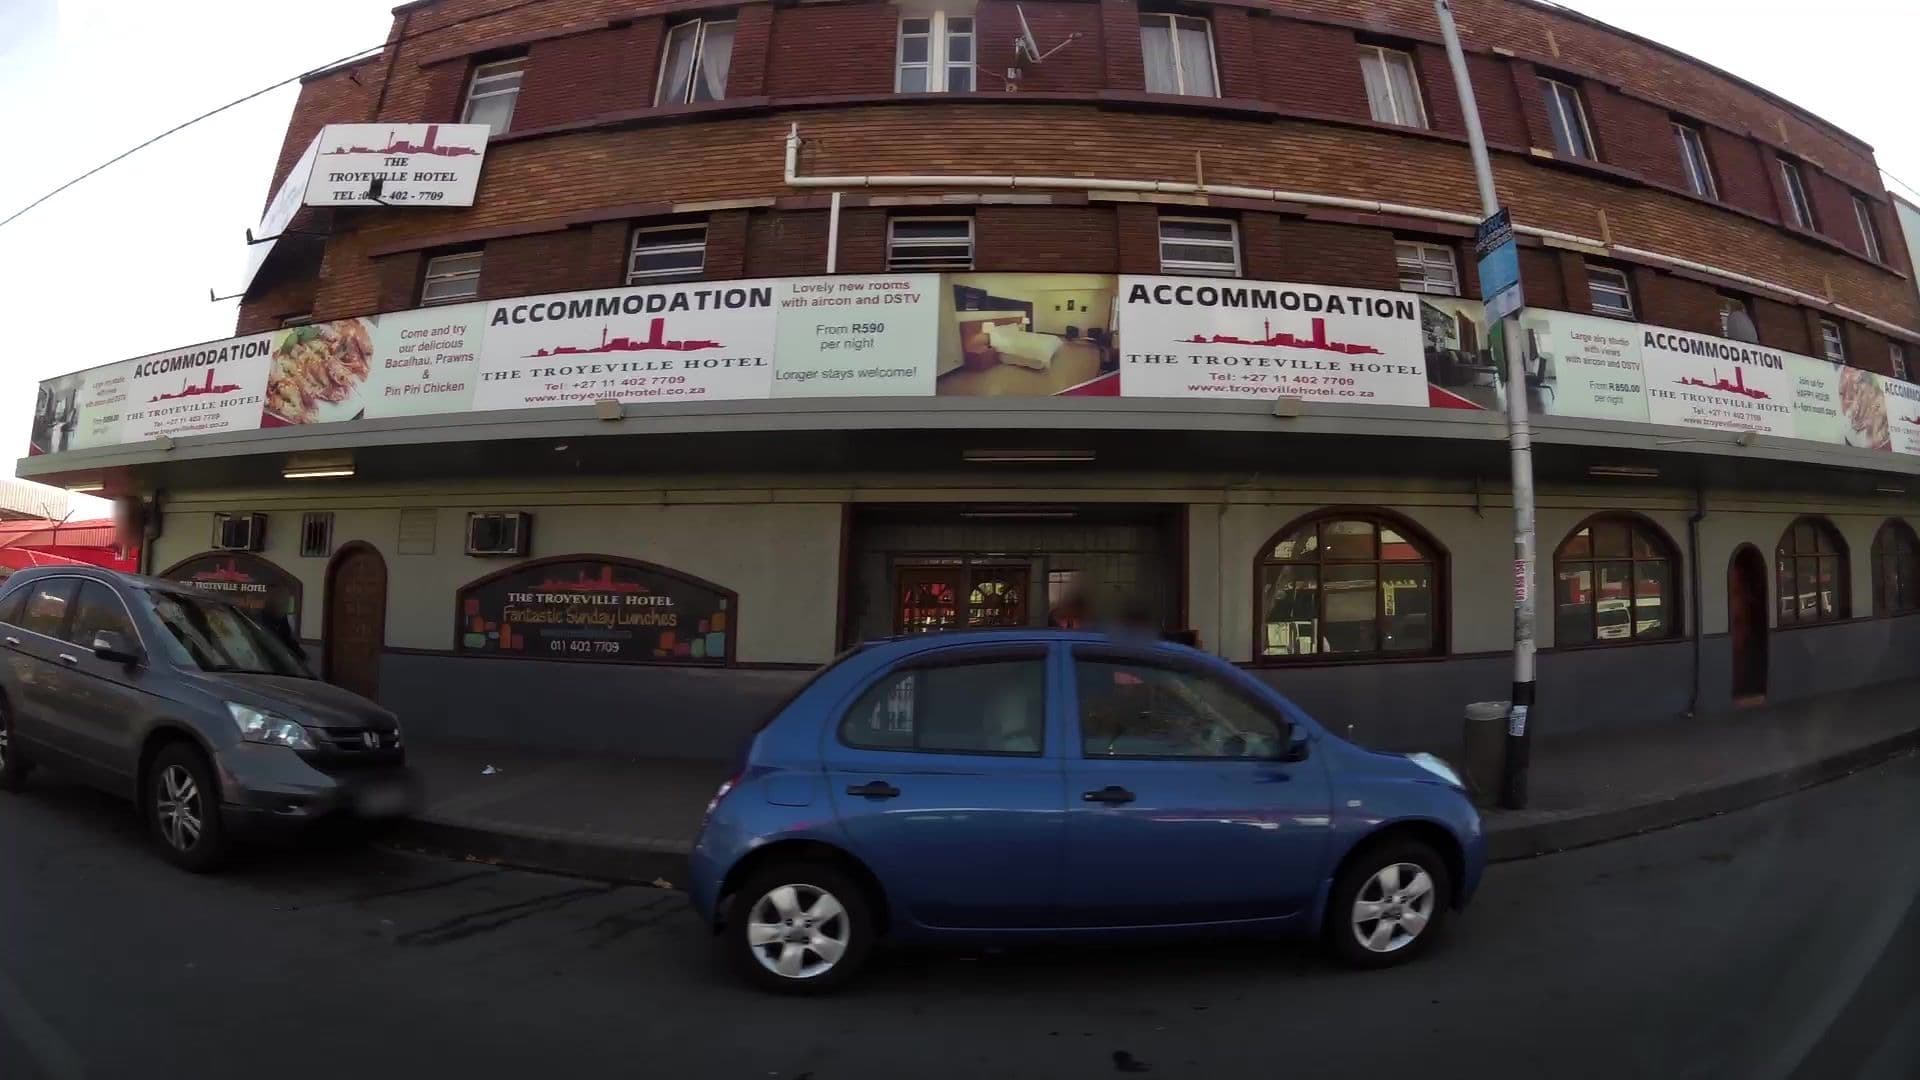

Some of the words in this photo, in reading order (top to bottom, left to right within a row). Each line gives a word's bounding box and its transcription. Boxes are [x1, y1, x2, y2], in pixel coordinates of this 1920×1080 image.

[383, 157, 409, 167] THE
[328, 172, 408, 182] TROYEVILLE
[413, 172, 458, 182] HOTEL
[389, 191, 408, 201] 402
[419, 191, 444, 201] 7709
[792, 283, 834, 294] Lovely
[839, 282, 864, 291] new
[868, 281, 910, 290] rooms
[491, 287, 772, 326] ACCOMMODATION
[781, 296, 808, 308] with
[811, 296, 852, 306] aircon
[856, 295, 880, 305] and
[884, 294, 920, 304] DSTV
[1128, 283, 1415, 321] ACCOMMODATION
[400, 327, 428, 340] Come
[431, 326, 450, 338] and
[452, 324, 467, 337] try
[816, 324, 848, 336] From
[852, 323, 884, 334] R590
[1571, 329, 1591, 342] Large
[399, 344, 415, 353] our
[418, 338, 464, 352] delicious
[820, 340, 840, 351] per
[844, 338, 874, 350] night
[1644, 332, 1783, 370] ACCOMMODATION
[134, 339, 271, 379] ACCOMMODATION
[435, 351, 474, 365] Prawns
[1126, 354, 1179, 364] THE
[1188, 356, 1340, 371] TROYEVILLE
[1350, 362, 1422, 375] HOTEL
[481, 370, 522, 381] THE
[529, 360, 674, 378] TROYEVILLE
[685, 357, 768, 370] HOTEL
[1621, 361, 1640, 370] DSTV
[422, 369, 431, 380] &
[775, 369, 818, 382] Longer
[821, 368, 854, 380] stays
[858, 366, 917, 378] welcome!
[1241, 374, 1267, 382] +27
[1293, 376, 1318, 384] 402
[1323, 376, 1354, 386] 7709
[404, 383, 421, 395] Piri
[423, 381, 465, 395] Chicken
[572, 379, 597, 389] +27
[602, 379, 615, 388] 11
[620, 376, 647, 387] 402
[651, 375, 685, 385] 7709
[126, 412, 144, 420] THE
[148, 402, 216, 417] TROYEVILLE
[220, 396, 262, 407] HOTEL
[1649, 389, 1677, 400] THE
[1681, 393, 1753, 409] TROYEVILLE
[1757, 403, 1791, 414] HOTEL
[240, 583, 267, 593] HOTEL
[508, 592, 533, 603] THE
[535, 593, 619, 605] TROYEVILLE
[626, 596, 674, 606] HOTEL
[503, 605, 561, 623] Fantastic
[566, 608, 615, 629] Sunday
[618, 608, 677, 626] Lunches
[550, 641, 566, 651] 011
[570, 641, 591, 651] 402
[594, 641, 620, 652] 7709
